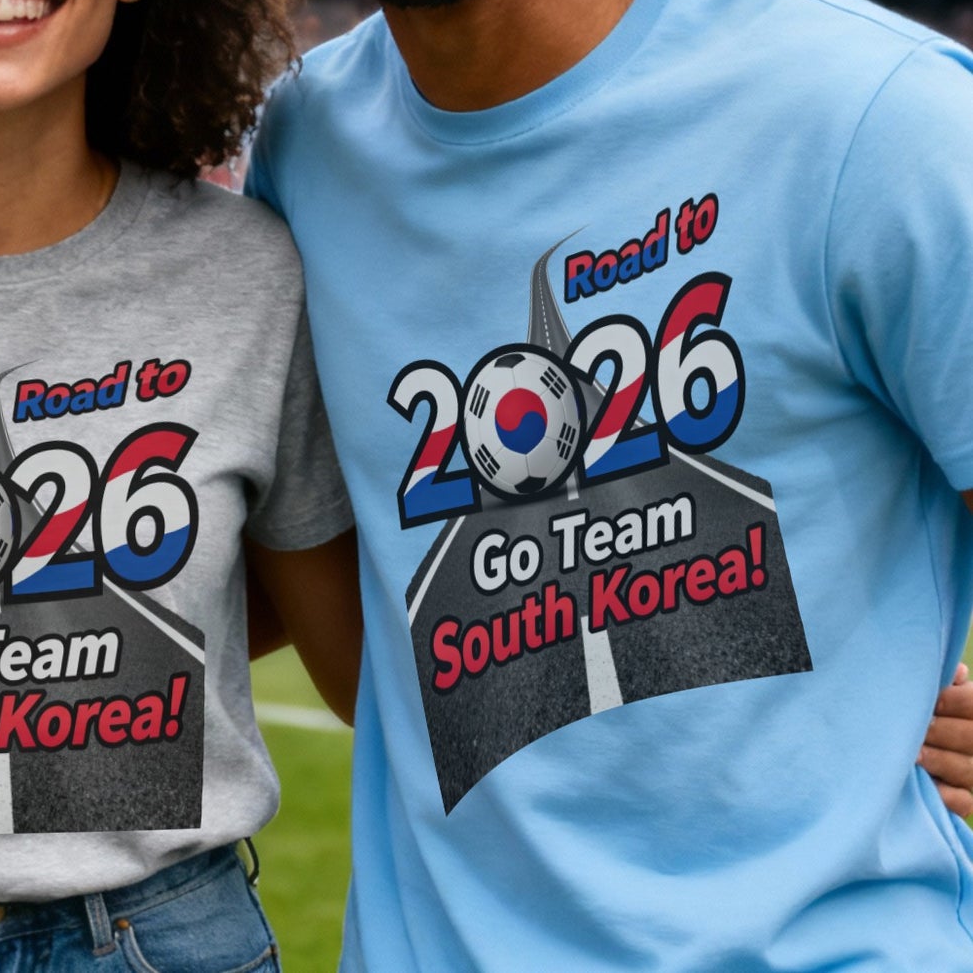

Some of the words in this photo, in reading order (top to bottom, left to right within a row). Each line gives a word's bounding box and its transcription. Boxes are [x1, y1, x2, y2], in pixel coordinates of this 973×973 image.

[564, 208, 670, 303] Road
[675, 193, 719, 256] to
[13, 359, 131, 423] Road
[135, 358, 191, 402] to
[470, 529, 544, 595] Go
[548, 492, 697, 572] Team
[428, 579, 579, 695] South
[587, 523, 769, 633] Korea!
